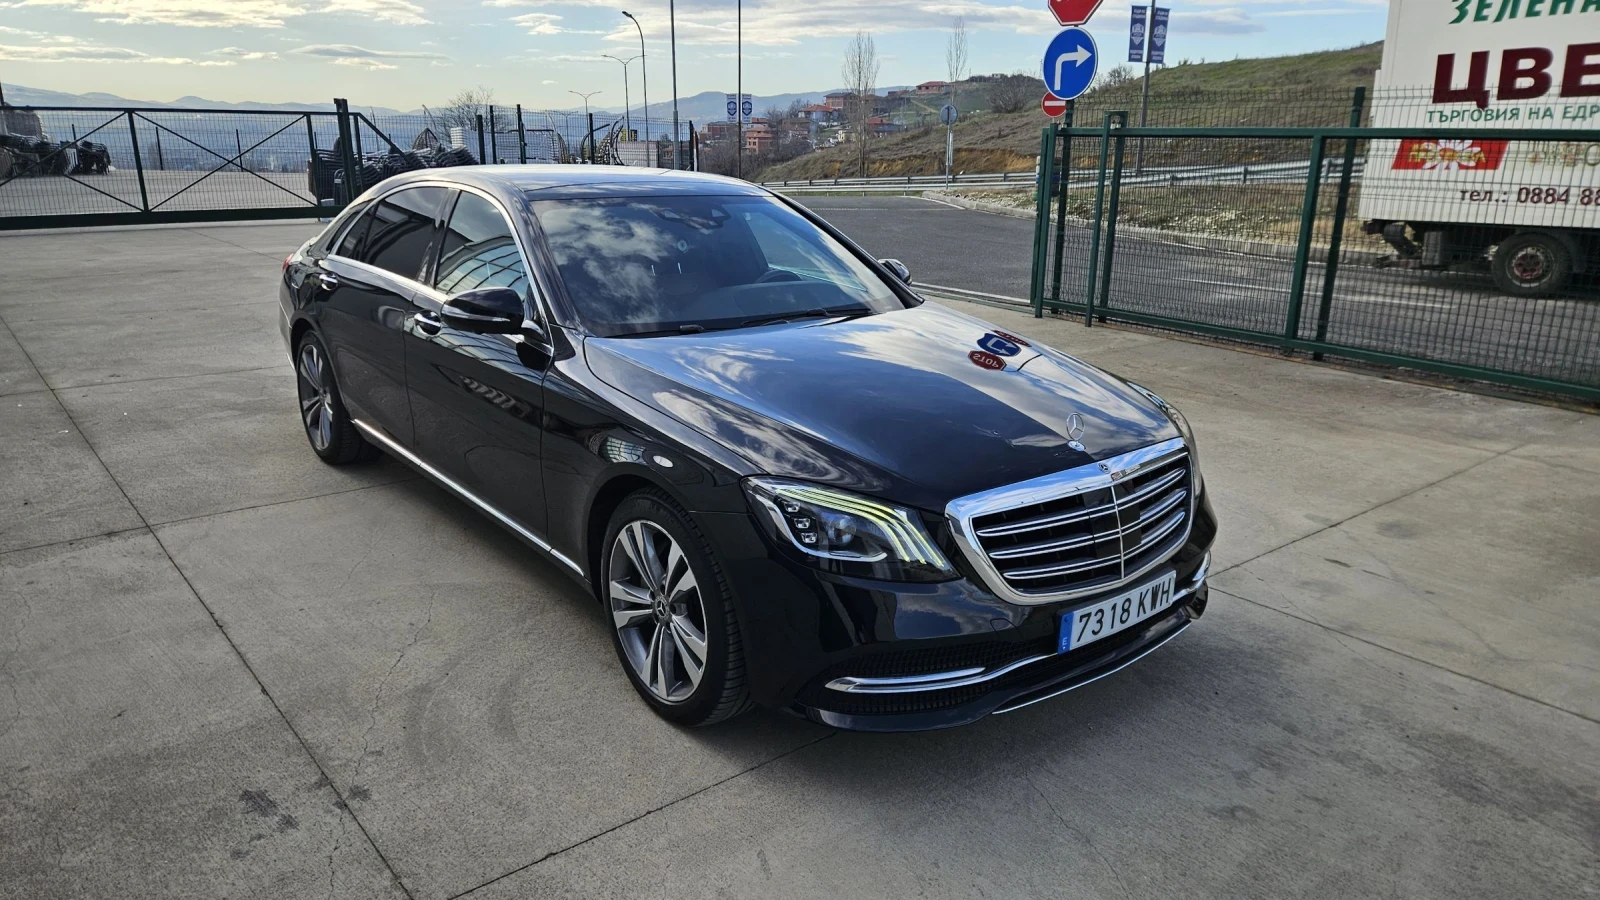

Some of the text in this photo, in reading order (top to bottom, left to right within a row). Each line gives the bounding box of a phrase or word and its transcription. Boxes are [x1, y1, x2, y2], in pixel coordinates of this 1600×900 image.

[1432, 42, 1600, 110] ЦВЕ
[1427, 107, 1521, 123] ТЪРГОВИЯ
[1528, 107, 1554, 121] НА
[1517, 186, 1571, 205] 0884
[1076, 577, 1172, 643] 7318 KWH
